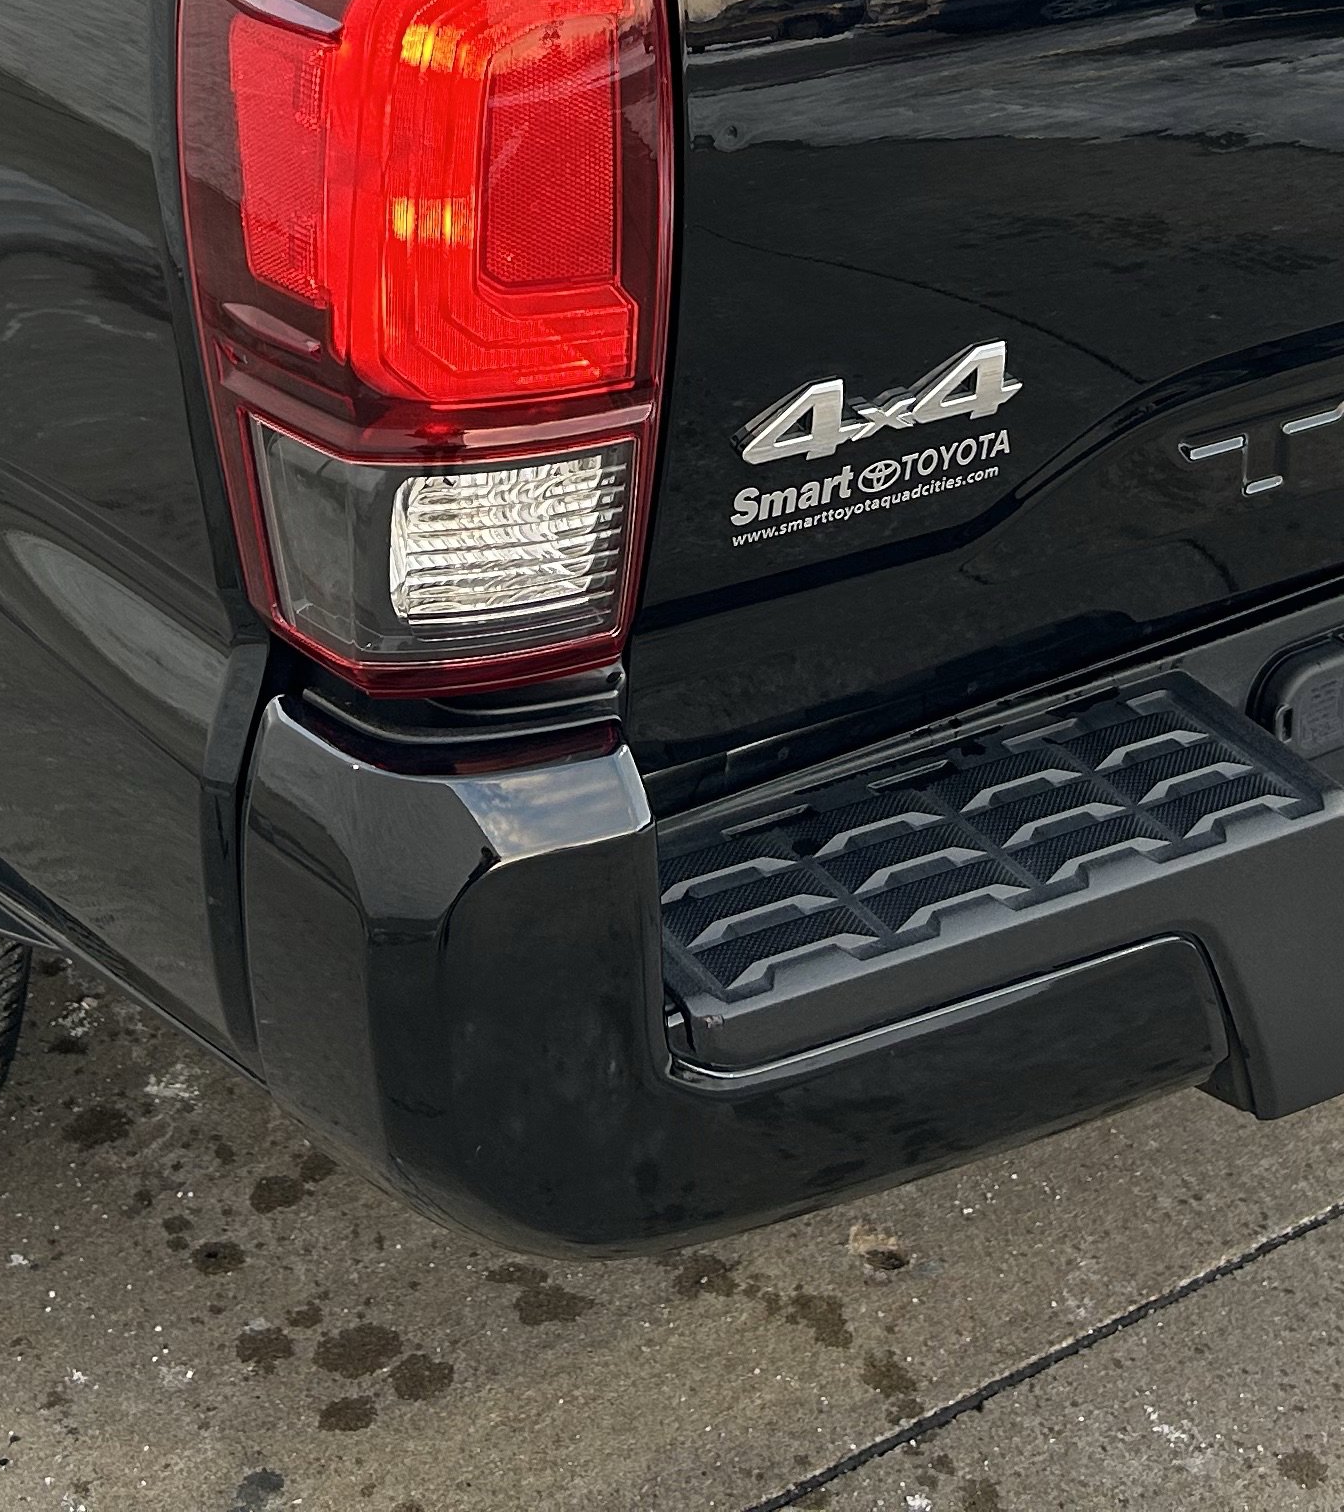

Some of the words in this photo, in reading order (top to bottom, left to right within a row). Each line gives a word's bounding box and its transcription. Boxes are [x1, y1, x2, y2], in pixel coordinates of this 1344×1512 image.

[741, 339, 1023, 465] 4x4
[730, 465, 854, 527] Smart
[901, 429, 1011, 482] TOYOTA
[731, 464, 1000, 548] www.smarttoyotaquadcities.com
